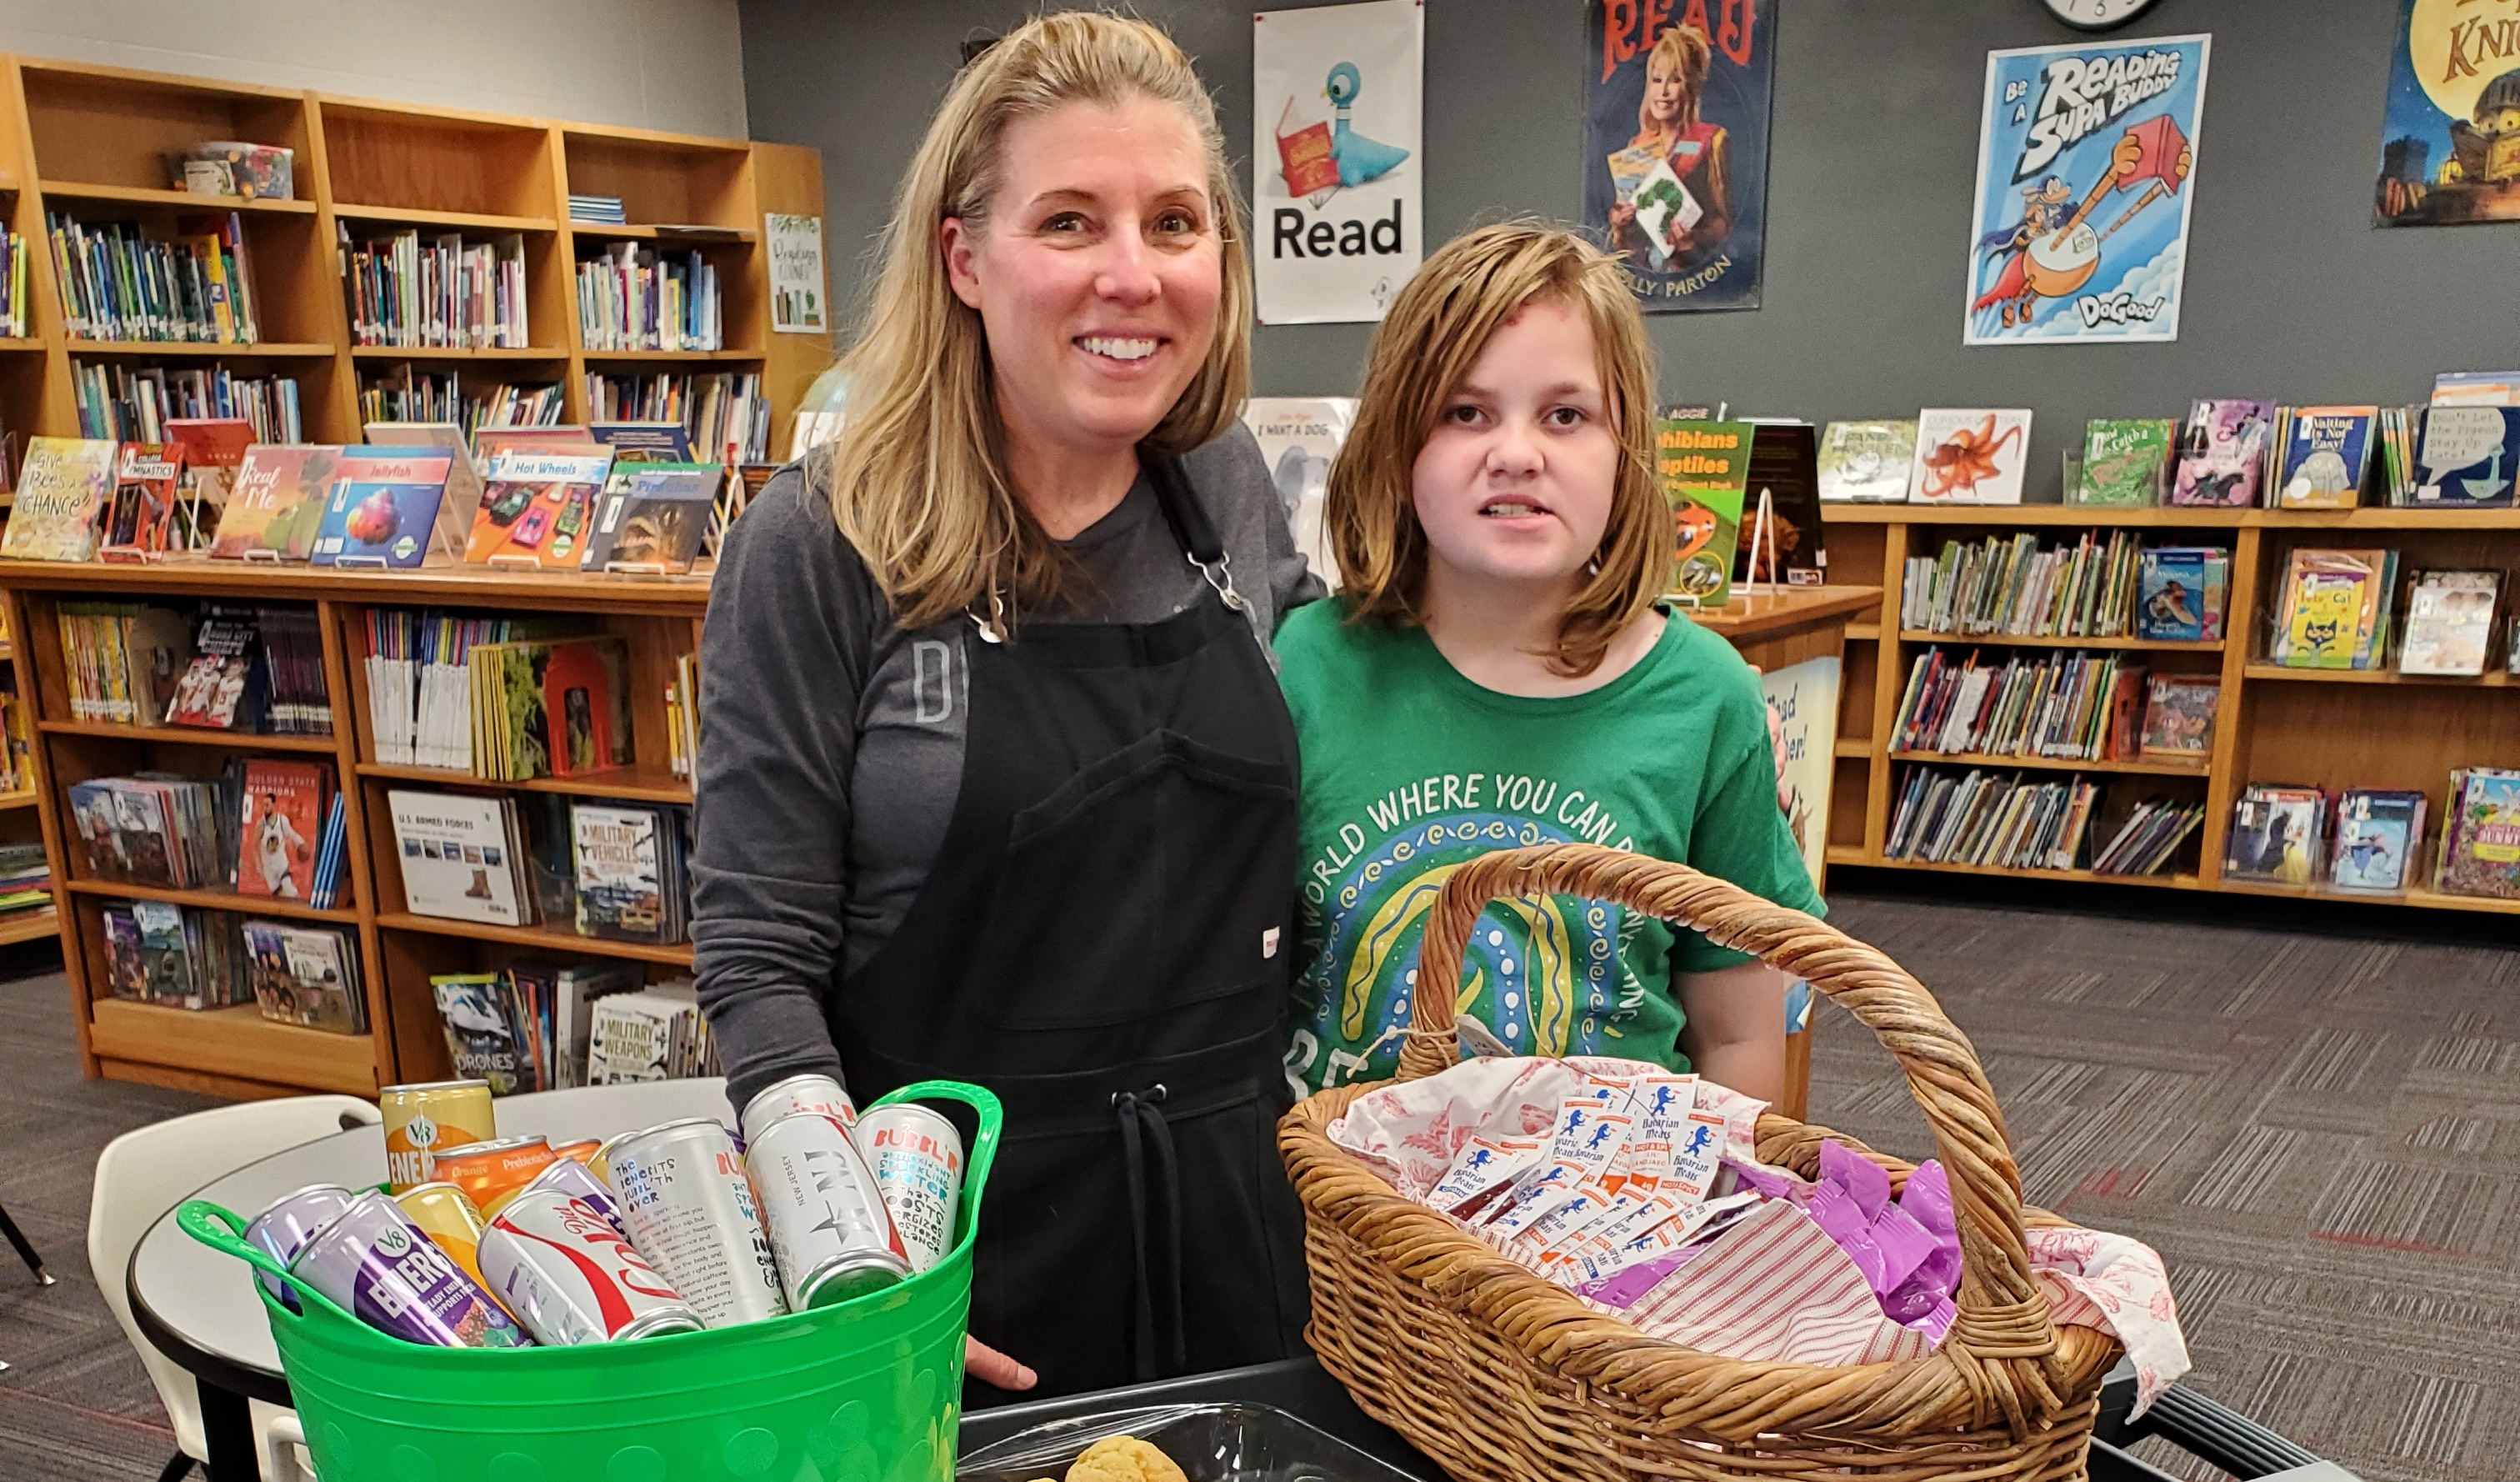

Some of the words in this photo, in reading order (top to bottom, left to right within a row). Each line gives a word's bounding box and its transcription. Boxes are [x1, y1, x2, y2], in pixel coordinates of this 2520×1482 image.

[2442, 14, 2520, 83] KNI
[2014, 103, 2027, 122] A
[2019, 98, 2107, 175] SUPA
[2110, 75, 2178, 117] BUDDY
[1273, 198, 1402, 259] Read
[1666, 253, 1732, 298] PARTON
[2077, 292, 2166, 328] DoGood
[1294, 424, 1302, 436] A
[1305, 423, 1329, 436] DOG
[515, 462, 534, 475] Hot
[538, 461, 577, 476] Wheels
[1659, 455, 1729, 476] eptiles
[1301, 823, 1366, 928] WORLD
[1366, 773, 1484, 832] WHERE
[1495, 774, 1557, 814] YOU
[1558, 790, 1618, 846] CAN
[607, 1018, 655, 1042] MILITARY
[605, 1039, 654, 1061] WEAPONS
[456, 1052, 515, 1072] DRONES
[408, 1123, 432, 1144] V8
[874, 1128, 958, 1179] BUBBL'R
[1672, 1154, 1710, 1174] Bavarian
[452, 1164, 489, 1179] Orange
[781, 1155, 798, 1185] JERSEY
[1673, 1166, 1699, 1182] Meats
[792, 1184, 807, 1207] NEW
[885, 1194, 944, 1225] OOSTS
[378, 1228, 407, 1250] V8
